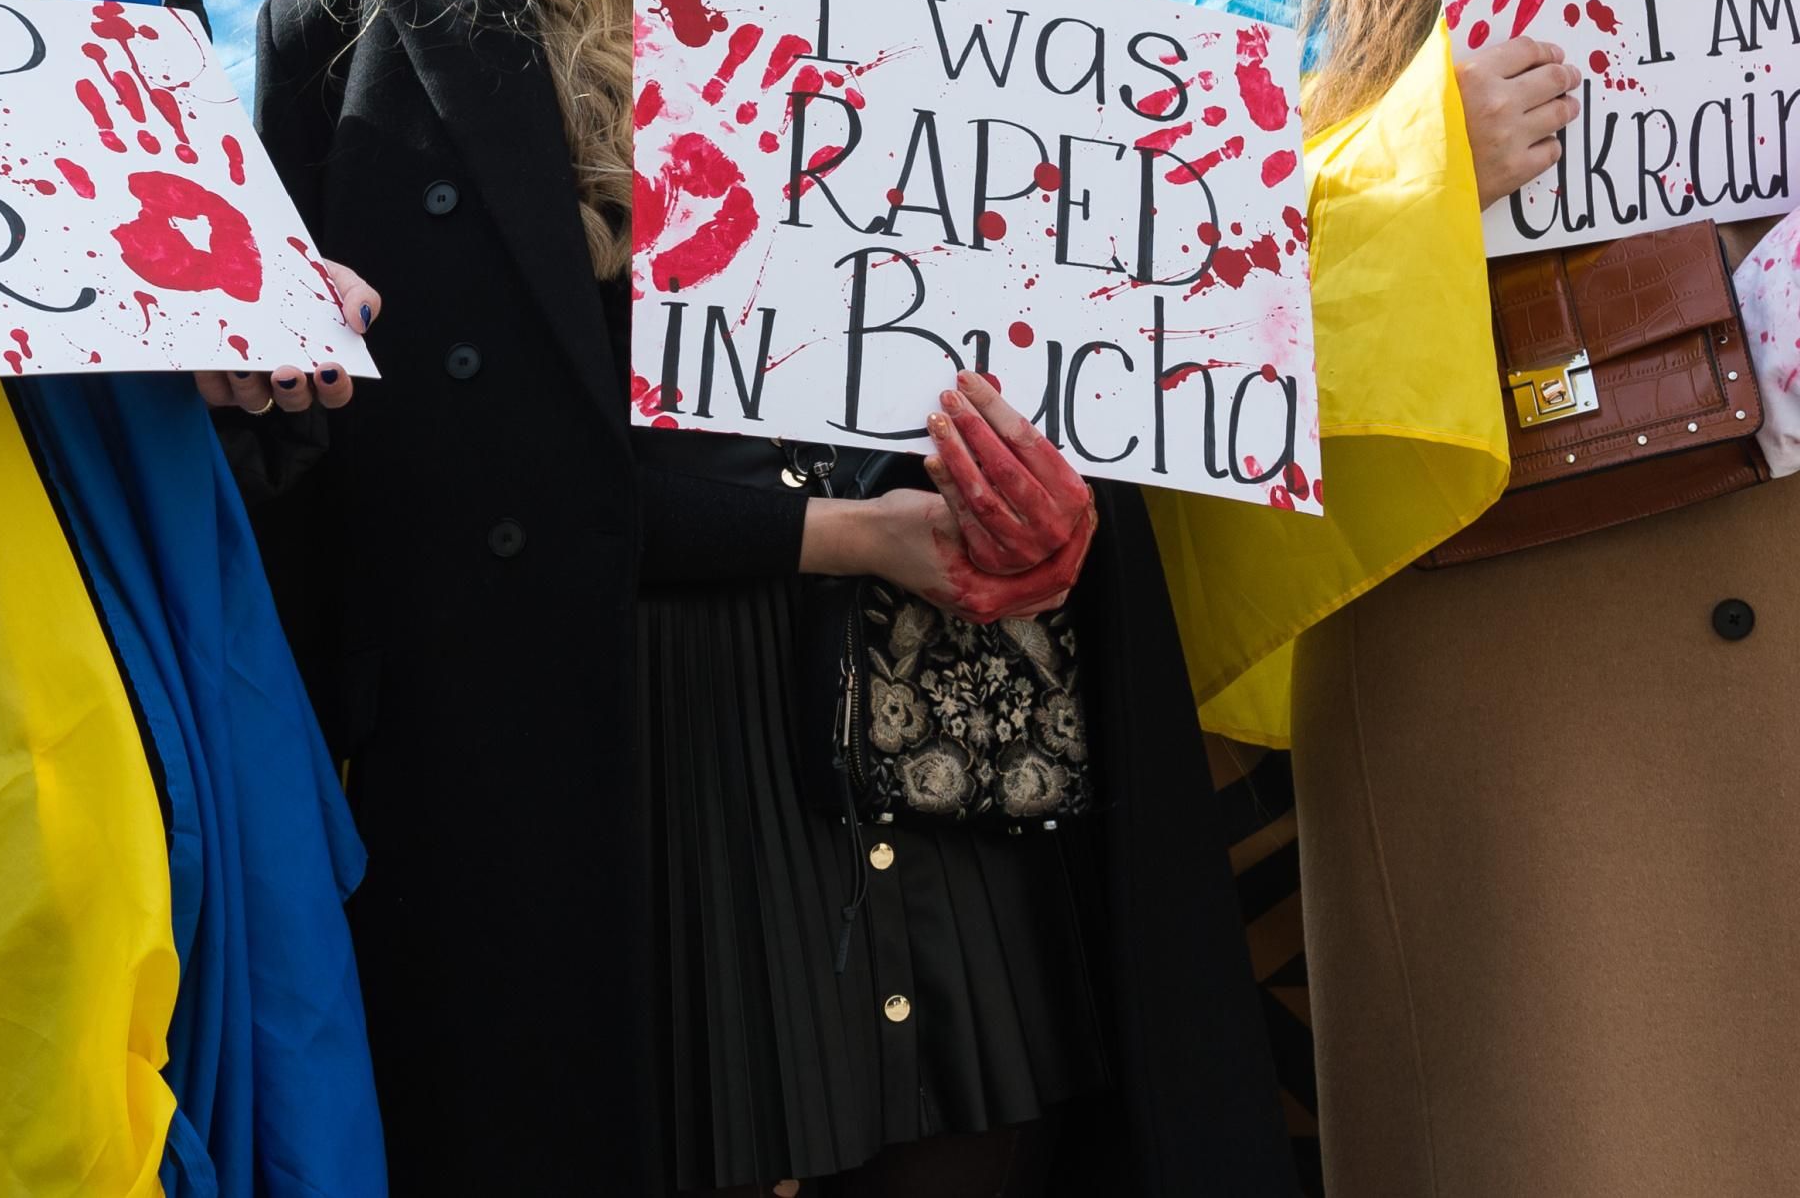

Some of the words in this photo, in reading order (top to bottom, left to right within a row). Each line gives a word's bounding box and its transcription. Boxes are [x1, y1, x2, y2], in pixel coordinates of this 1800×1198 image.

[779, 90, 1220, 286] RAPED
[660, 301, 777, 421] IN
[826, 247, 1298, 484] Bucha
